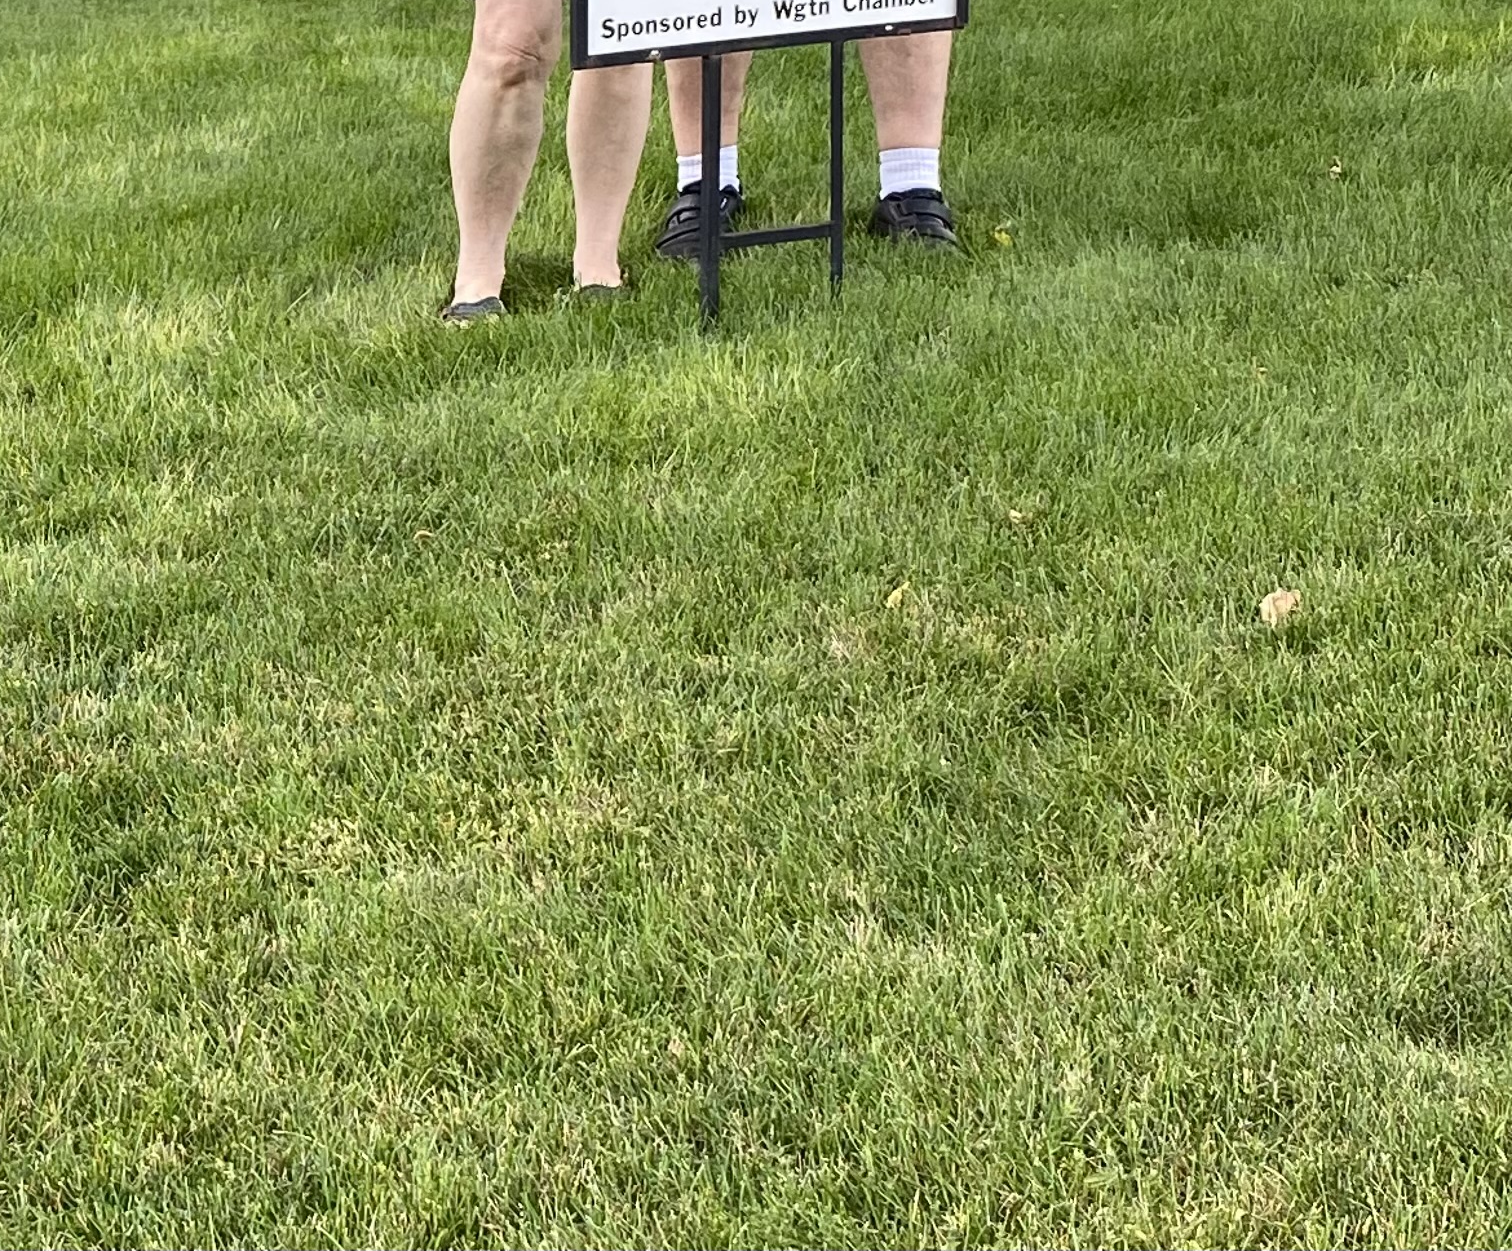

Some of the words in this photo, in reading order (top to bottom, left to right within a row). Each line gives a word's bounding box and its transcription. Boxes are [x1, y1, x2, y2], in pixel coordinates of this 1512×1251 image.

[601, 6, 722, 42] Sponsored
[734, 4, 759, 28] by
[773, 0, 830, 22] Wgtn
